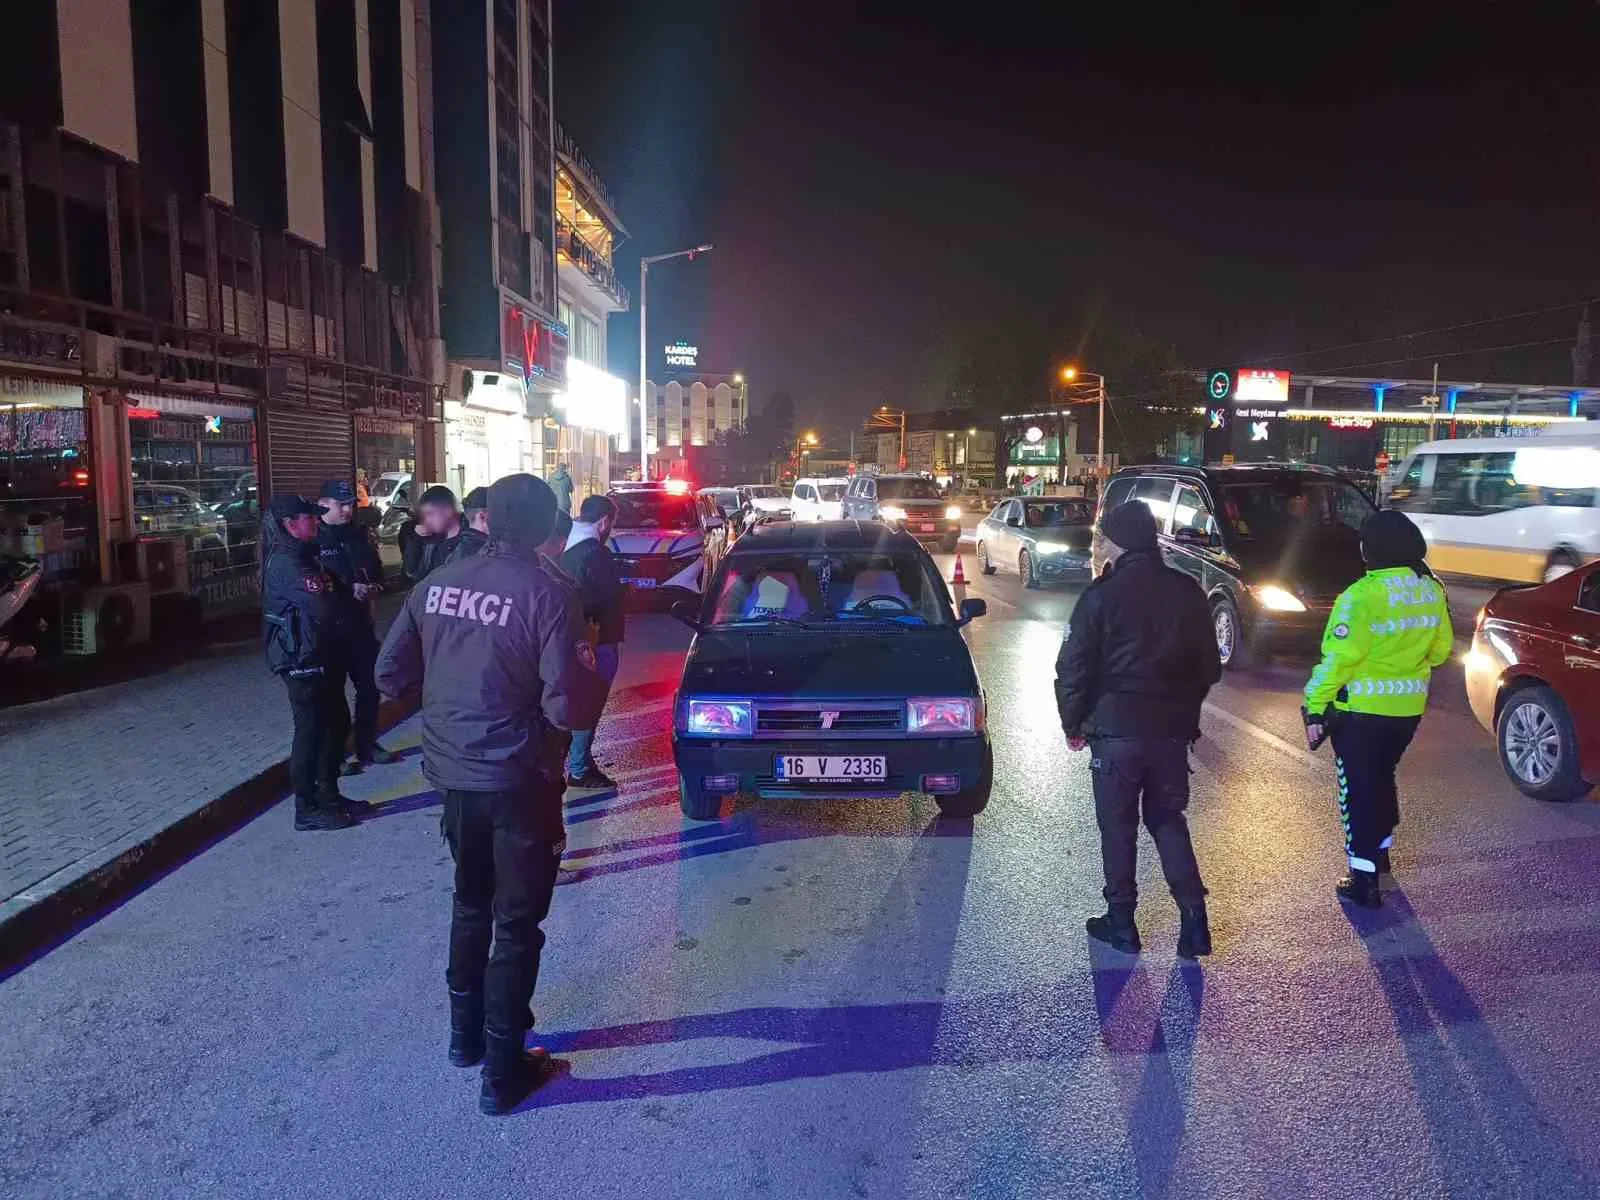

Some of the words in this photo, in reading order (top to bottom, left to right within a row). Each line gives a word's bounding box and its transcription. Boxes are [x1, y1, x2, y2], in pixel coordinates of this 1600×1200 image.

[667, 355, 697, 366] HOTEL
[786, 757, 804, 776] 16
[817, 757, 828, 776] V
[842, 757, 882, 776] 2336
